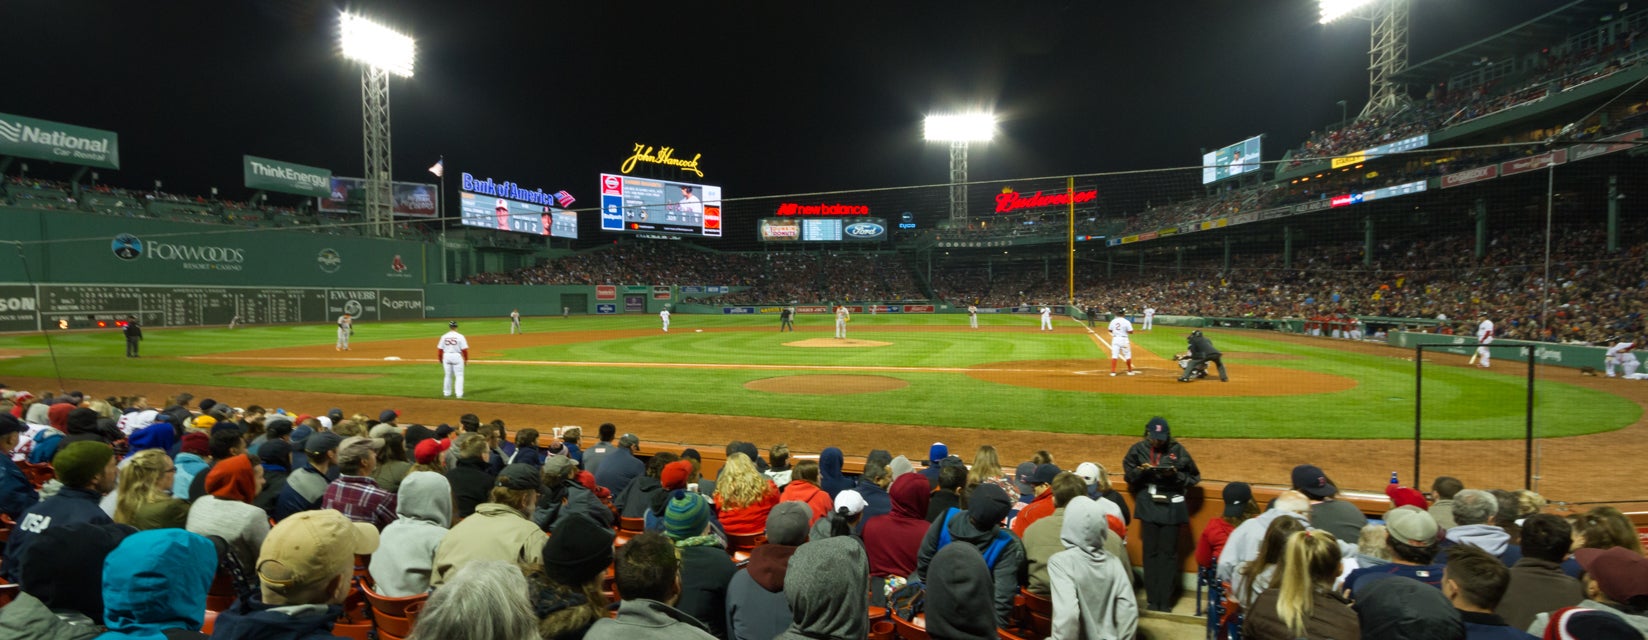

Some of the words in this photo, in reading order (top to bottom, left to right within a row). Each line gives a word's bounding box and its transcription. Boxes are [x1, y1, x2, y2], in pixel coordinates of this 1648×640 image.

[22, 125, 109, 153] National
[53, 147, 71, 156] Car
[73, 150, 105, 161] Rental
[621, 143, 656, 174] John
[655, 145, 704, 178] Hancock
[251, 161, 329, 187] ThinkEnergy
[462, 172, 496, 196] Bank
[497, 181, 509, 198] of
[510, 182, 554, 206] America
[798, 205, 821, 215] new
[821, 203, 869, 215] balance
[851, 223, 877, 236] Ford
[391, 300, 422, 310] OPTUM
[1115, 322, 1121, 330] 2
[20, 512, 52, 533] USA
